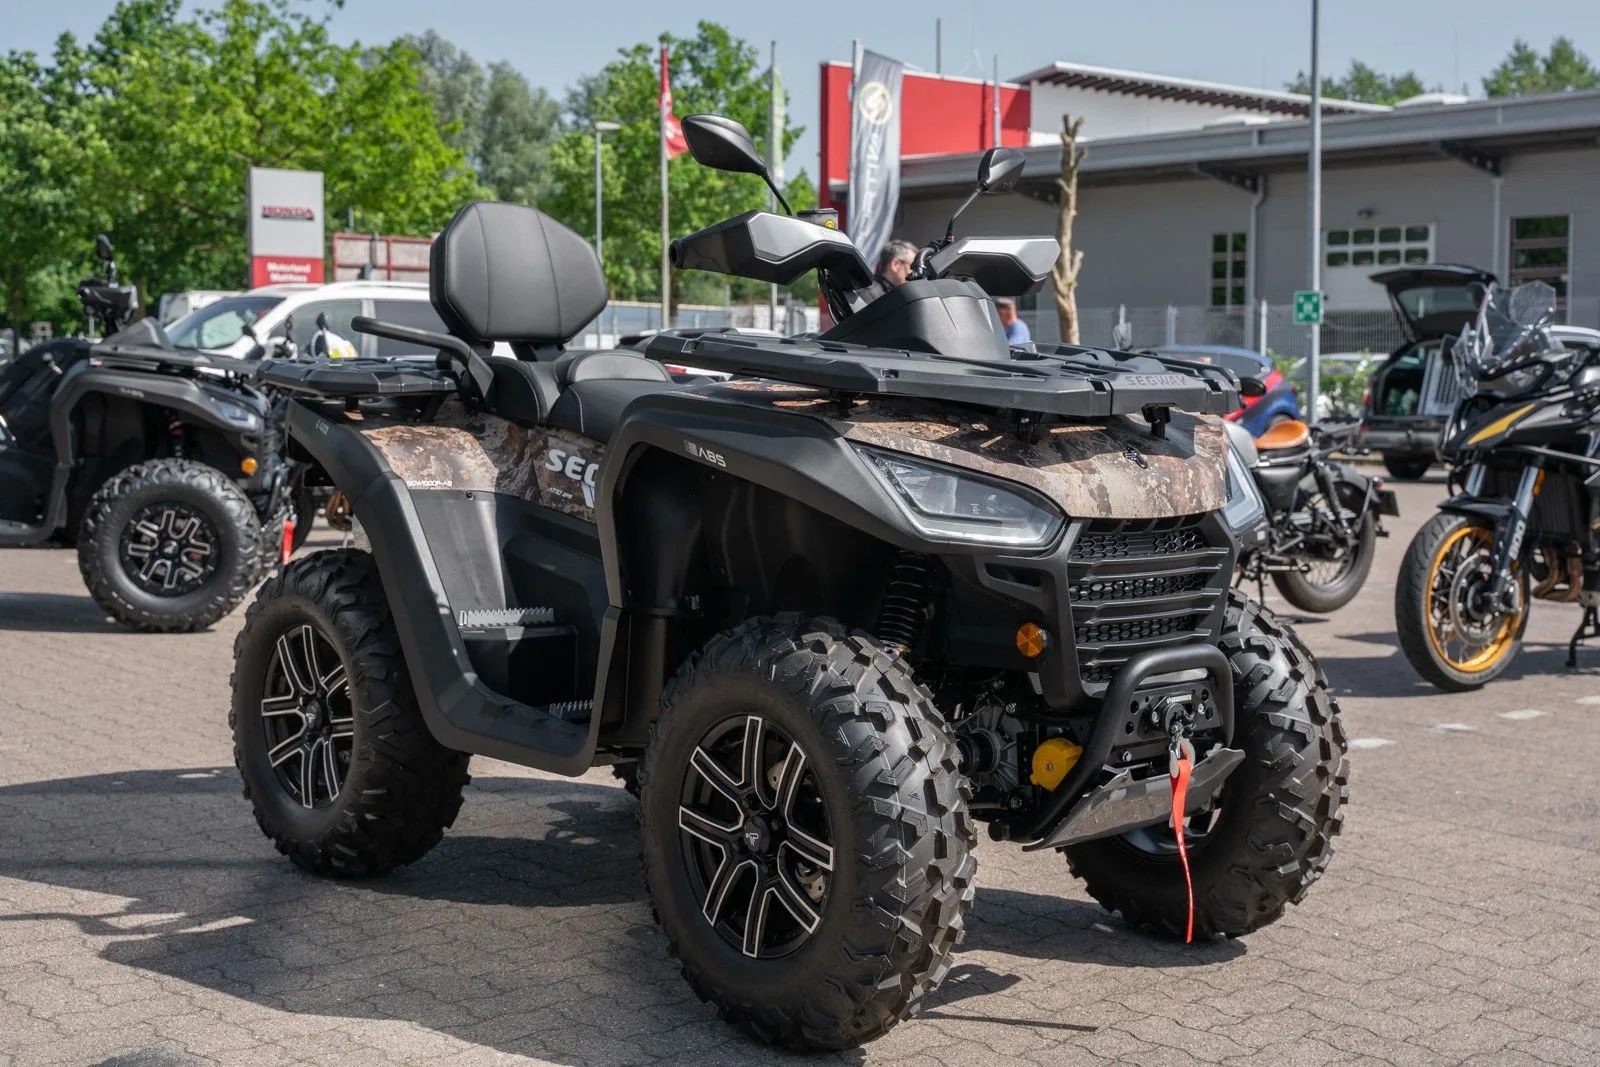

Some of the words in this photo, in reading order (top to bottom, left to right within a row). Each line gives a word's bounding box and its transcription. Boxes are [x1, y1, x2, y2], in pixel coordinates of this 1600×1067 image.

[262, 206, 314, 218] HONDA
[1125, 375, 1187, 386] SEGWAY
[699, 447, 727, 467] ABS
